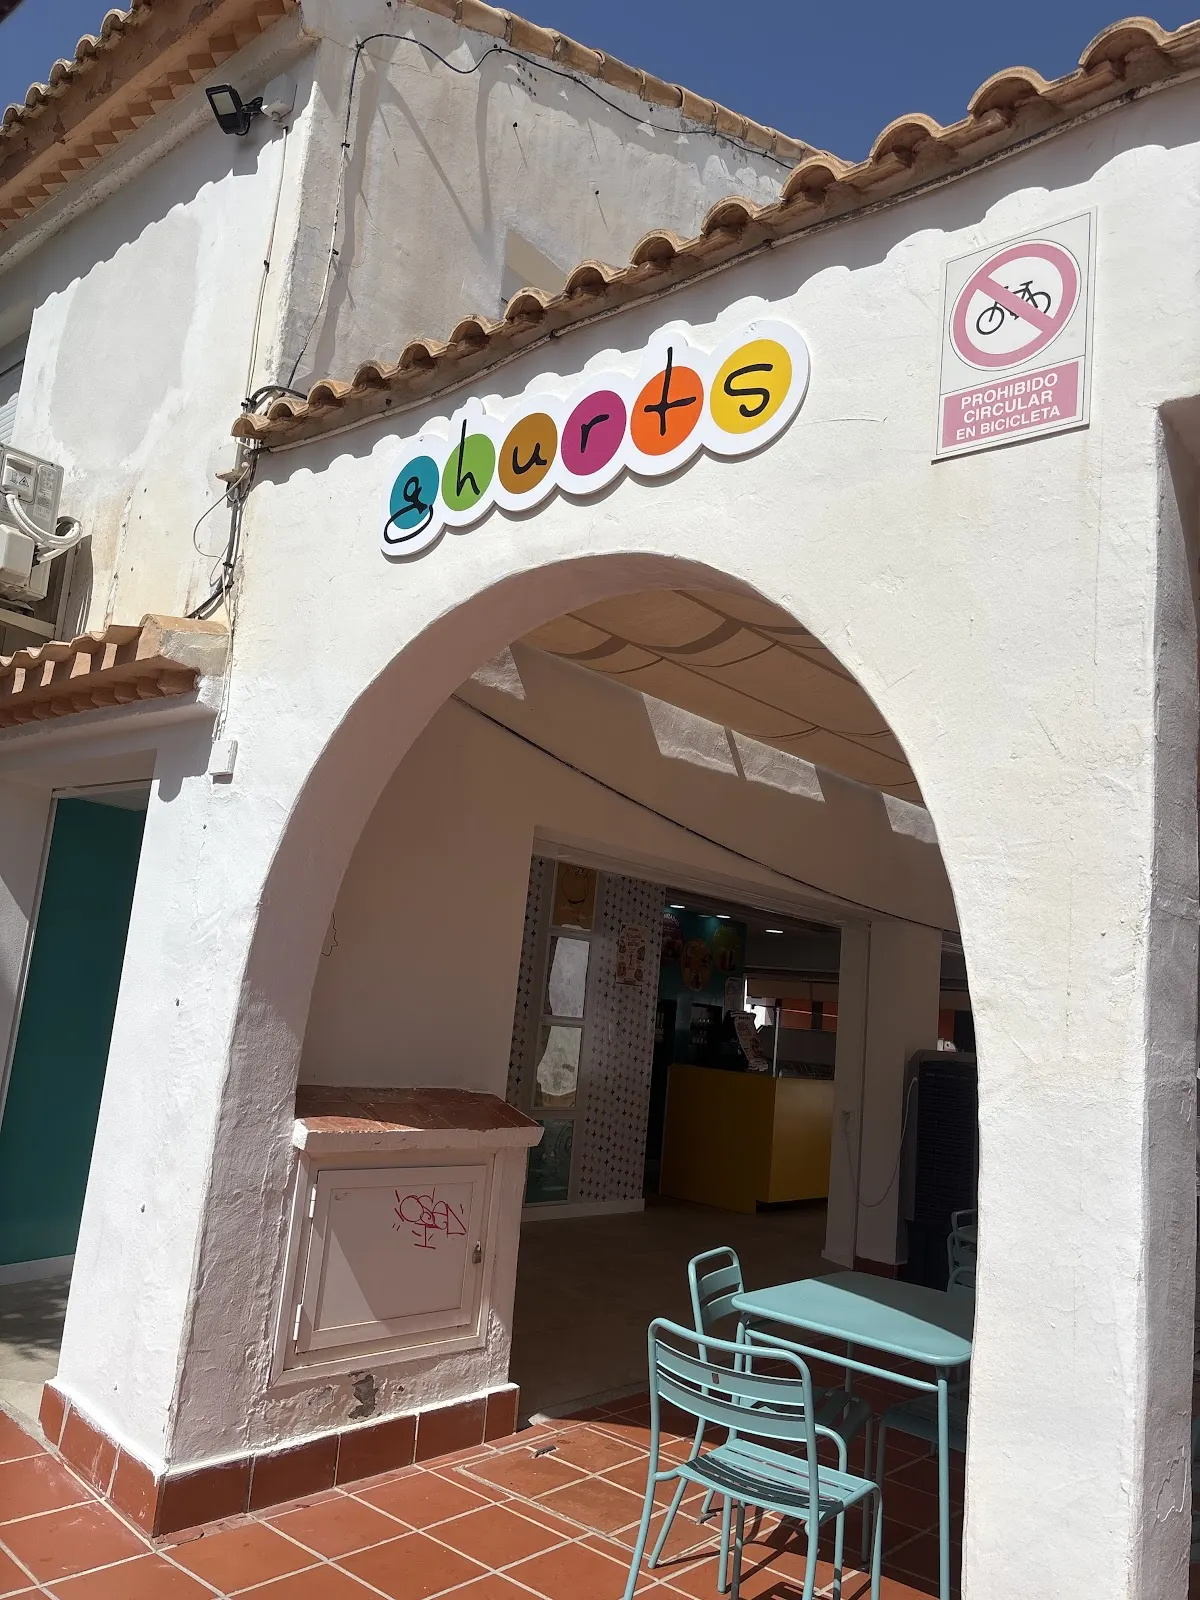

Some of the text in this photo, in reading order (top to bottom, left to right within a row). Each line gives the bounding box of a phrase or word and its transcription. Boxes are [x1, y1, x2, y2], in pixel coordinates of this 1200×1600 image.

[960, 372, 1058, 410] PROHIBIDO
[963, 390, 1053, 424] CIRCULAR
[956, 406, 1060, 441] EN BICICLETA
[383, 346, 774, 544] ghurts
